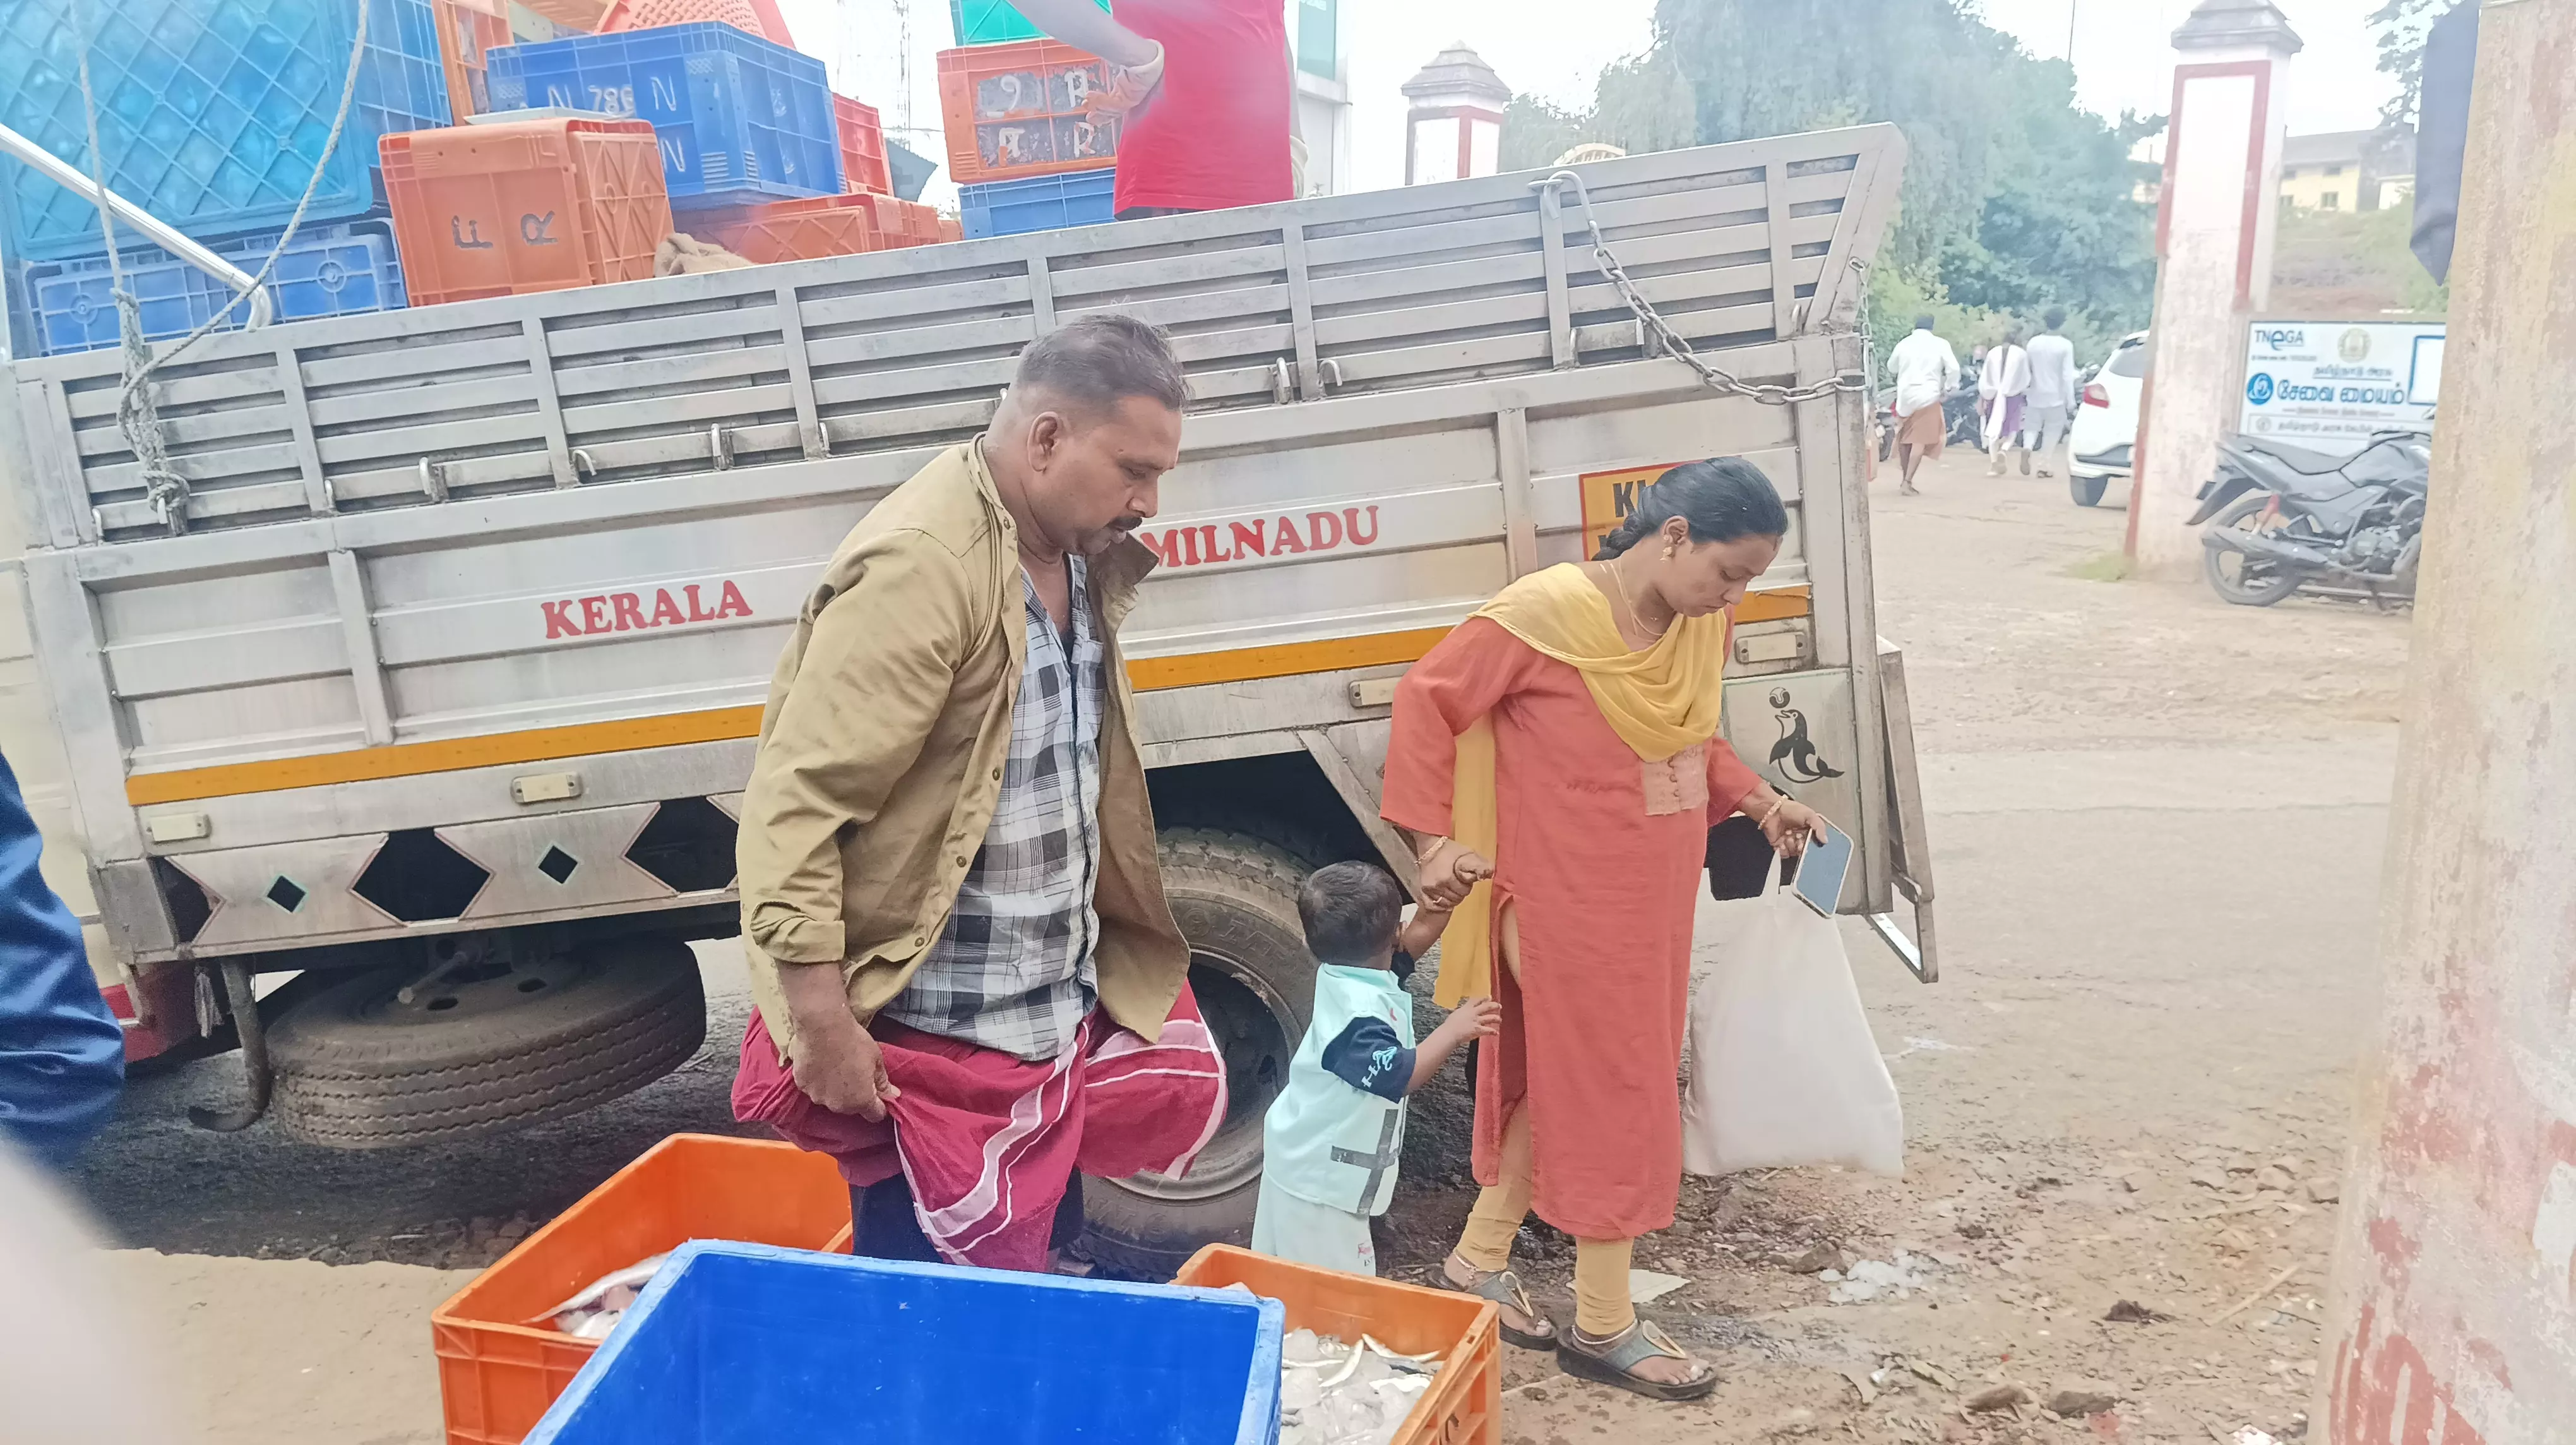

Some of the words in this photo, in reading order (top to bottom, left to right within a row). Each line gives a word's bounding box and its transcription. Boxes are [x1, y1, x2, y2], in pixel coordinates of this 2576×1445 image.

[650, 73, 677, 112] N
[520, 210, 559, 246] R
[2277, 379, 2335, 402] சேவை
[2340, 381, 2404, 404] மையம்
[540, 579, 754, 640] KERALA
